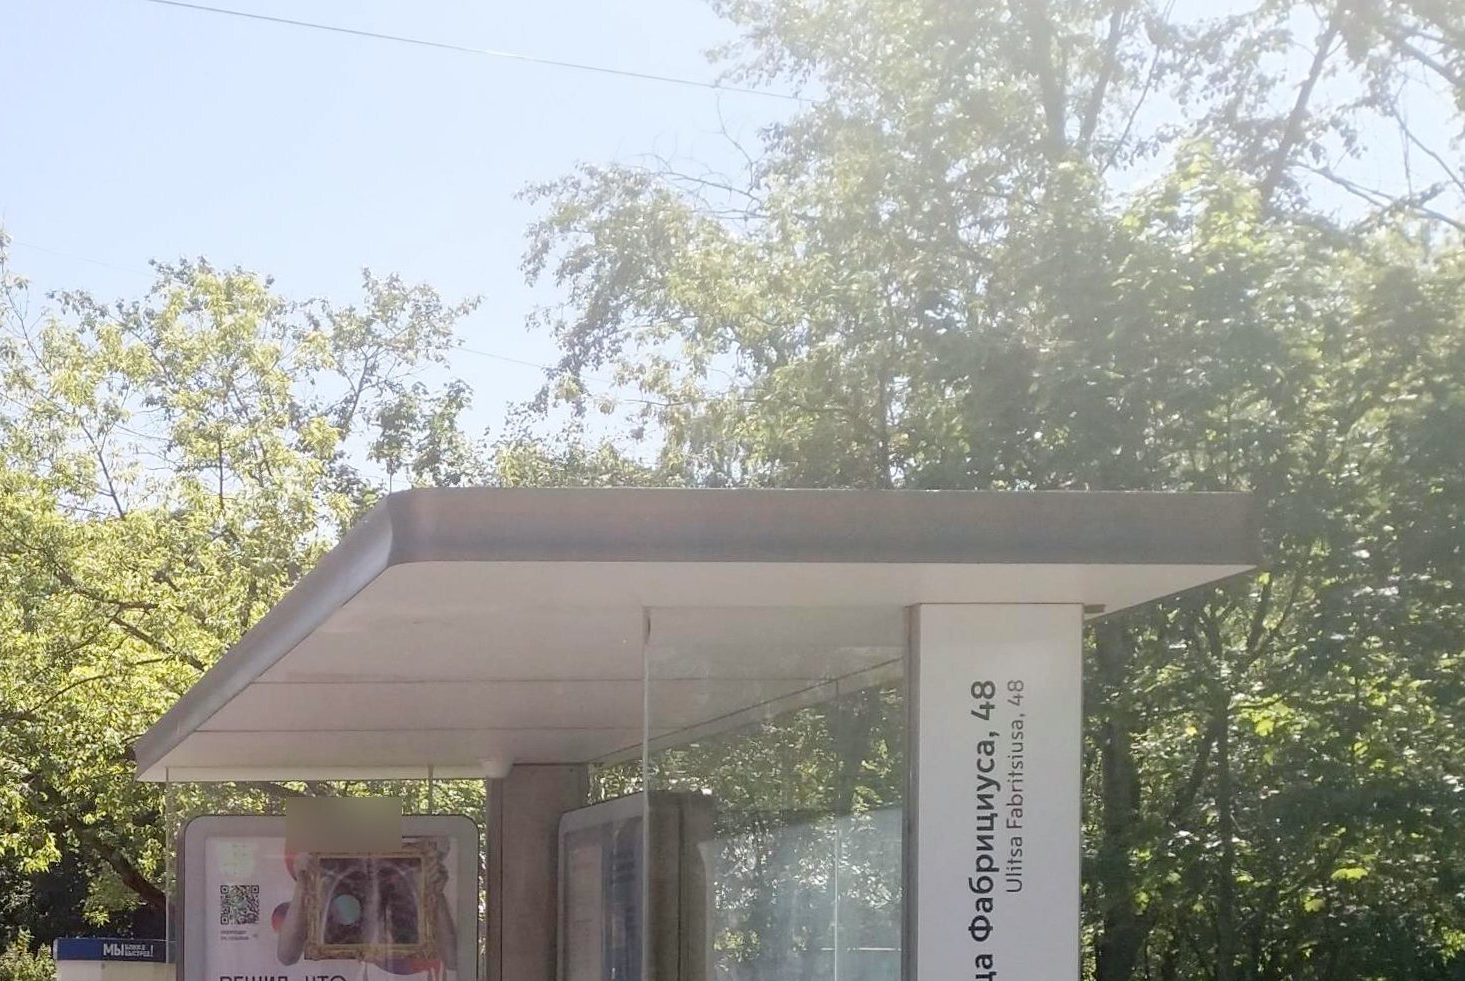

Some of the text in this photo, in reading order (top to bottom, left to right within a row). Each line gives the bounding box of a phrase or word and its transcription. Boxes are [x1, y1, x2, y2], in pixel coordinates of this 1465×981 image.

[971, 680, 996, 721] 48
[1006, 679, 1025, 893] Ulitsa Fabritsiusa, 48
[968, 731, 1000, 943] Фабрициуса,
